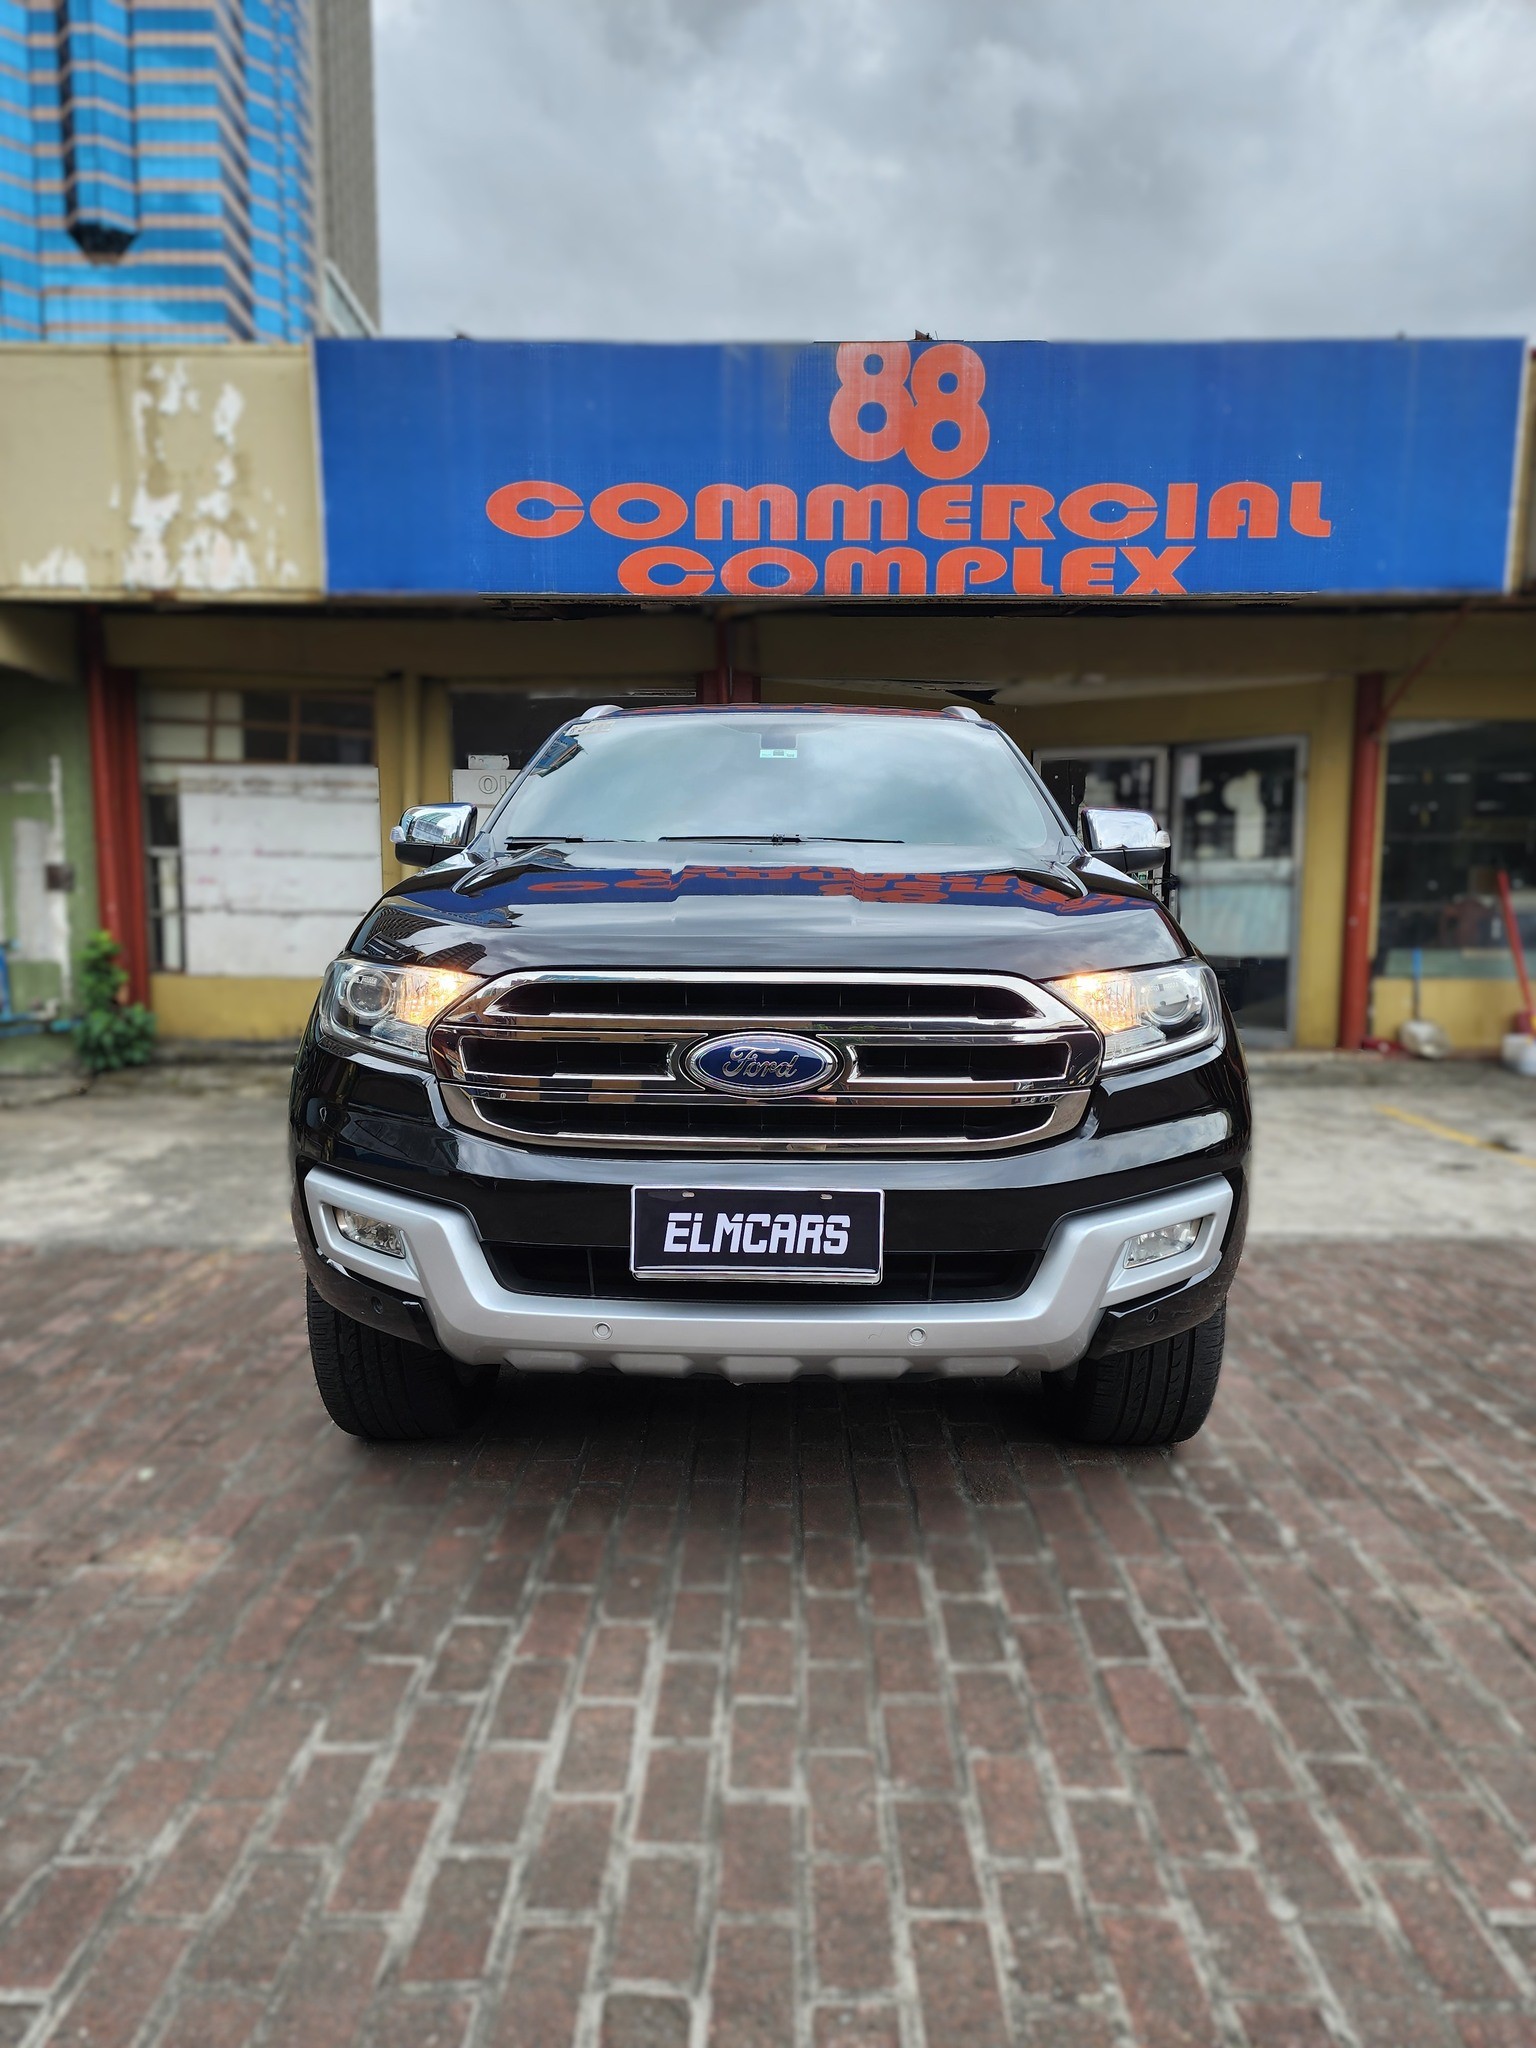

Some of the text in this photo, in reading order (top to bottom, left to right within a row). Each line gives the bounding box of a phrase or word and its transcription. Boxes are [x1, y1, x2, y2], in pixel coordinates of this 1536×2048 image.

[830, 342, 990, 480] 88
[486, 481, 1331, 540] COMMERCIAL
[618, 546, 1195, 597] COMPLEX
[722, 1046, 800, 1078] Ford
[663, 1212, 851, 1255] ELMCARS
